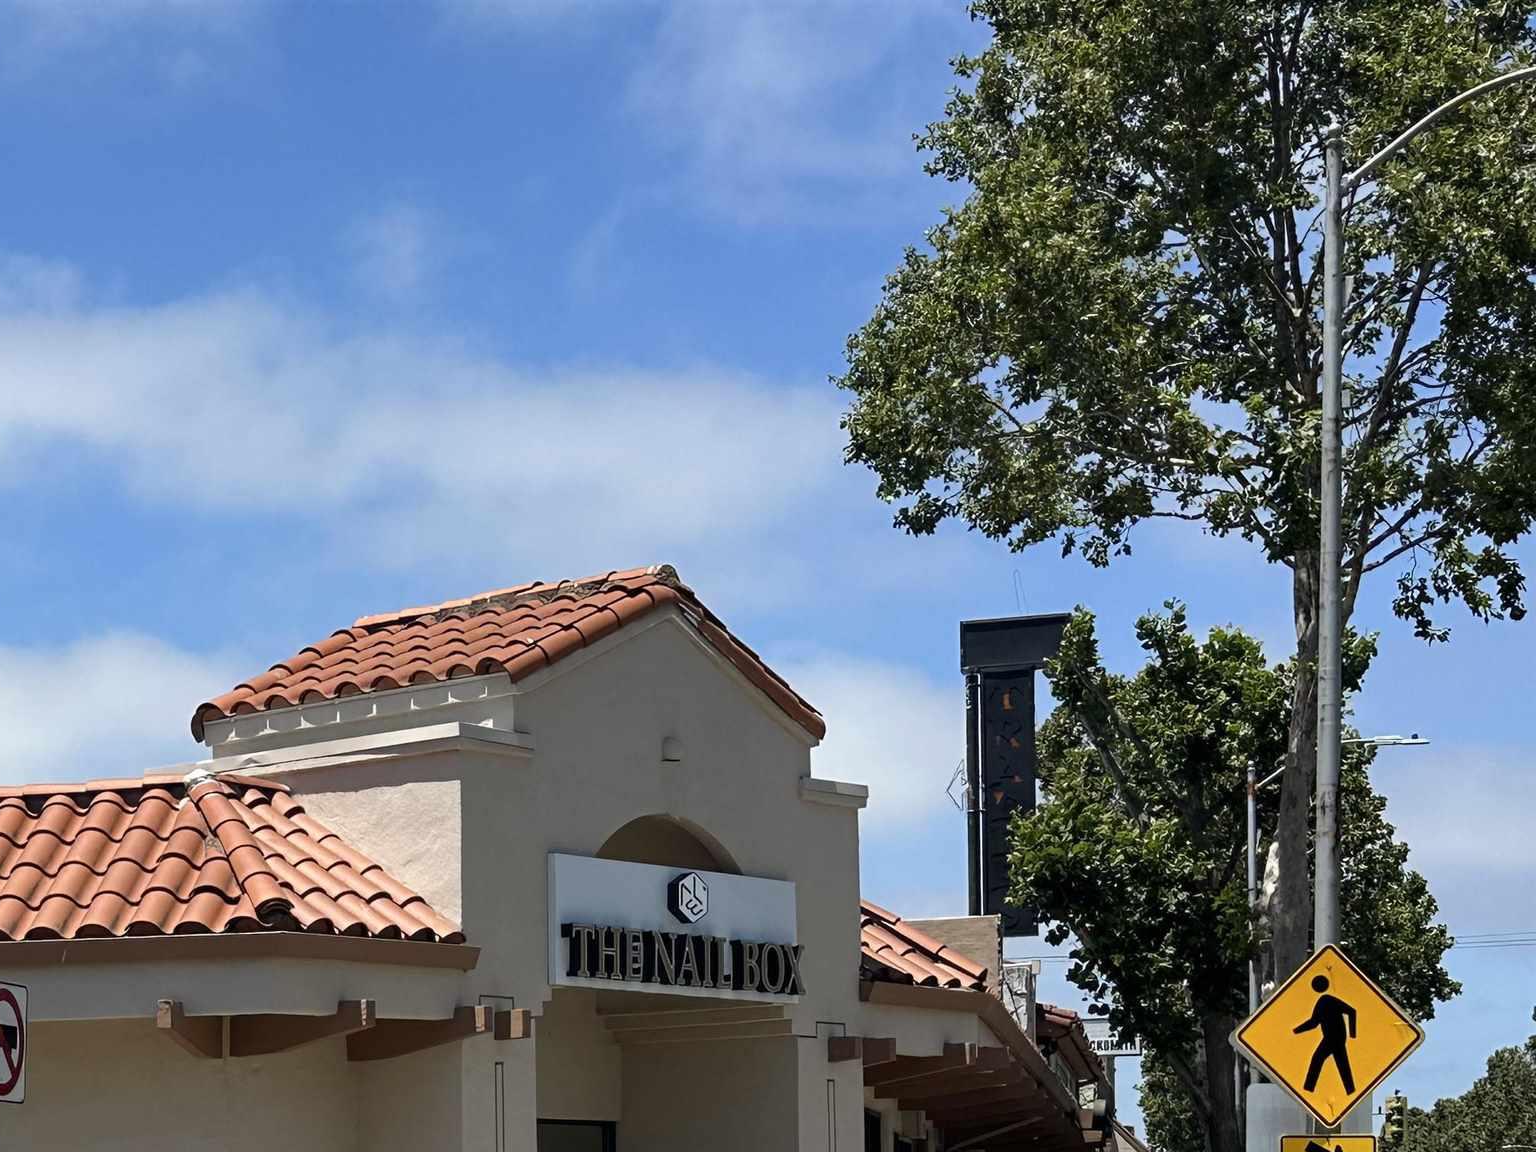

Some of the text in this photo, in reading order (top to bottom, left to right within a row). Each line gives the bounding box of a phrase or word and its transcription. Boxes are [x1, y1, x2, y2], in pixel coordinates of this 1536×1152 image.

[562, 923, 807, 996] THE NAIL BOX
